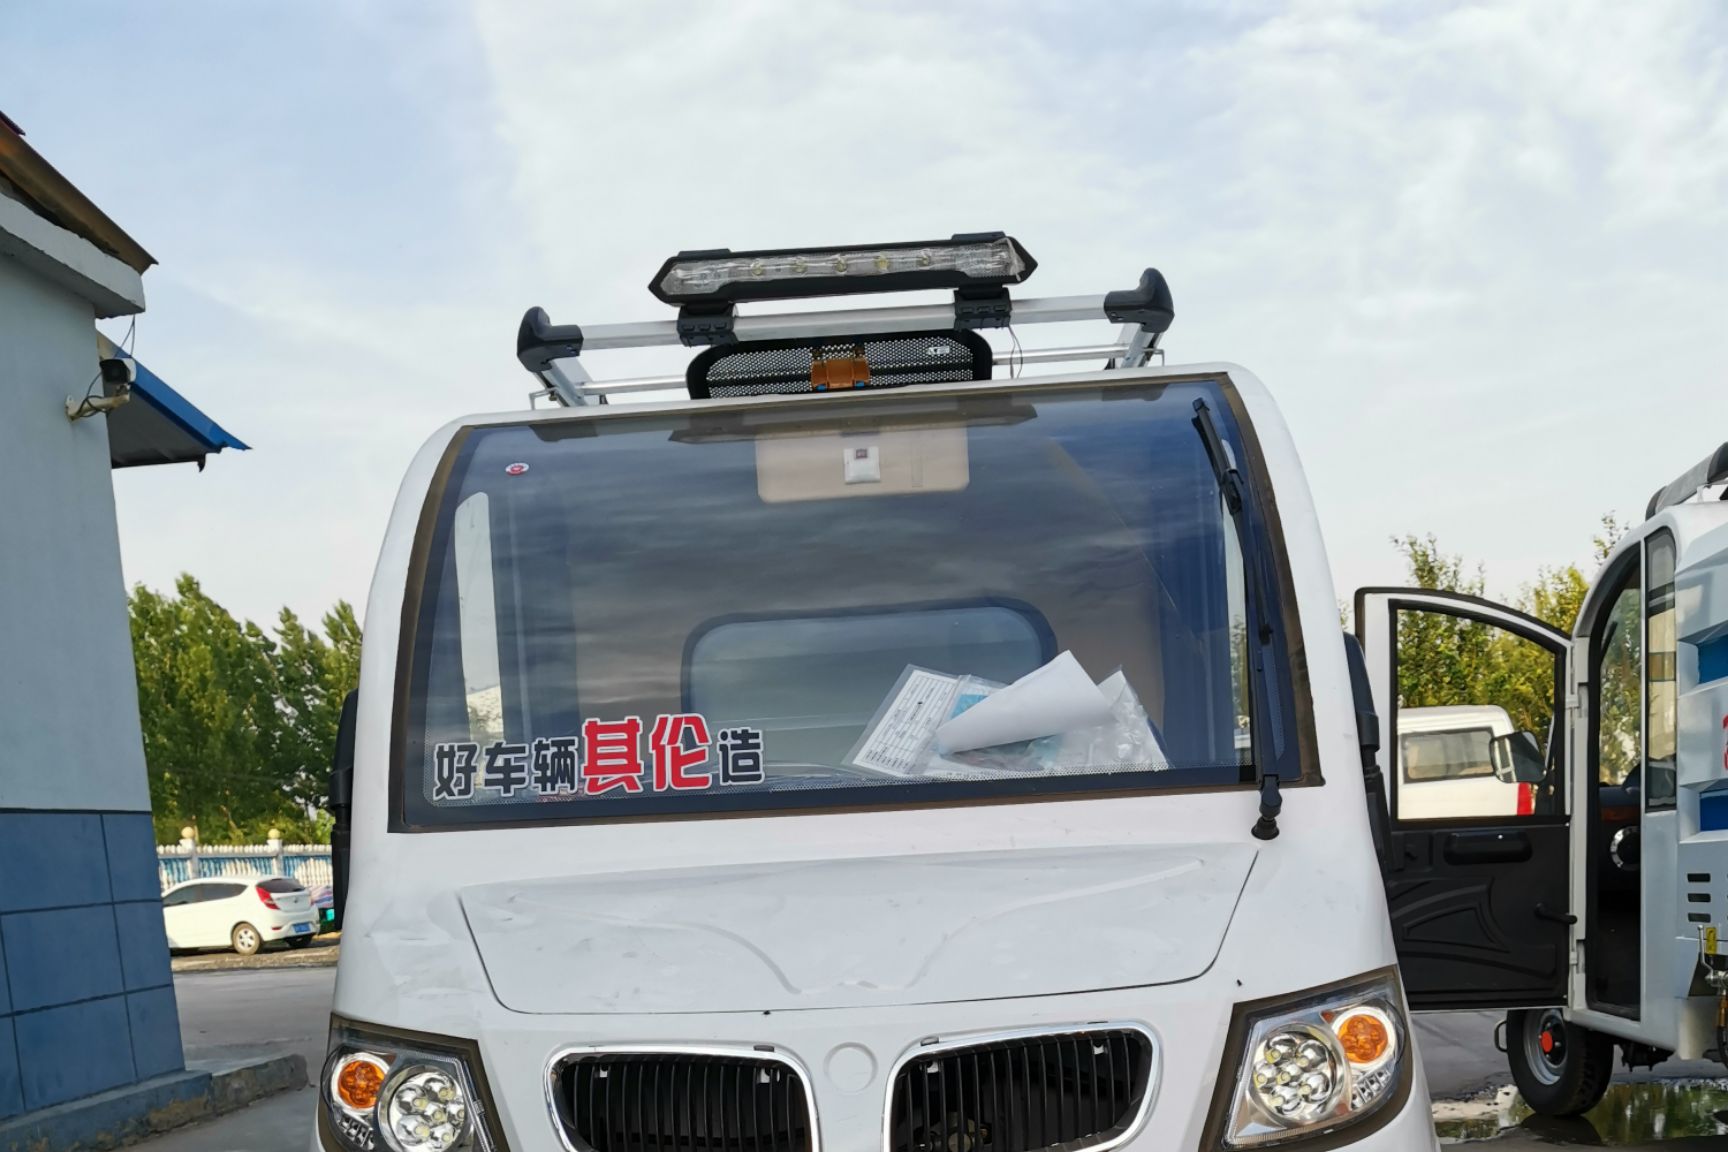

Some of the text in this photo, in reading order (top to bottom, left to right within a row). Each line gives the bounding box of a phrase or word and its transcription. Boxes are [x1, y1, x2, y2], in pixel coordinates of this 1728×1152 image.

[433, 713, 764, 799] 好车辆其伦造
